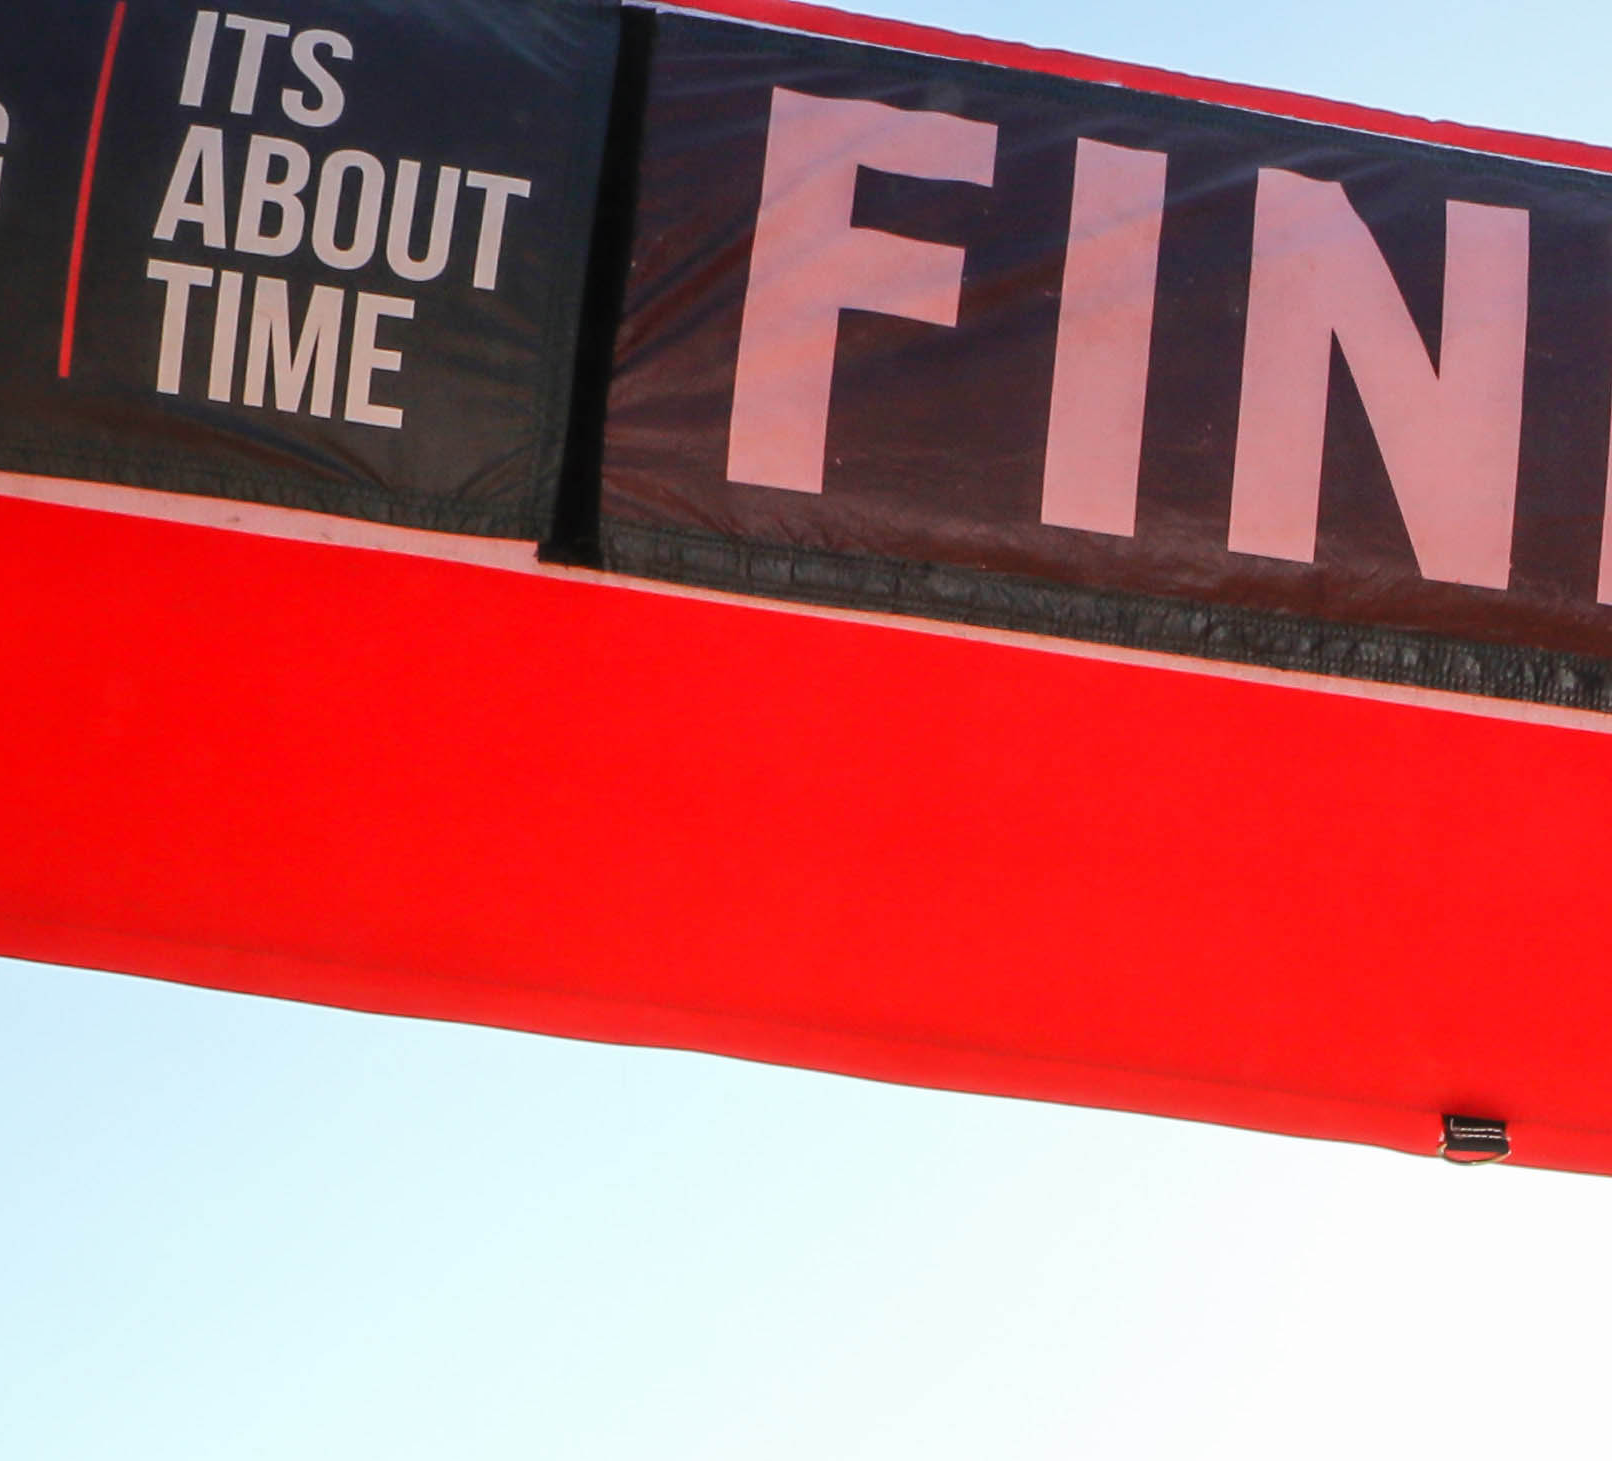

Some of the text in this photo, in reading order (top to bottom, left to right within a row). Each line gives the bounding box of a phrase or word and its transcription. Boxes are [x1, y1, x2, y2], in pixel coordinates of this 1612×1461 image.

[177, 9, 355, 129] ITS
[151, 127, 532, 292] ABOUT
[145, 260, 417, 430] TIME
